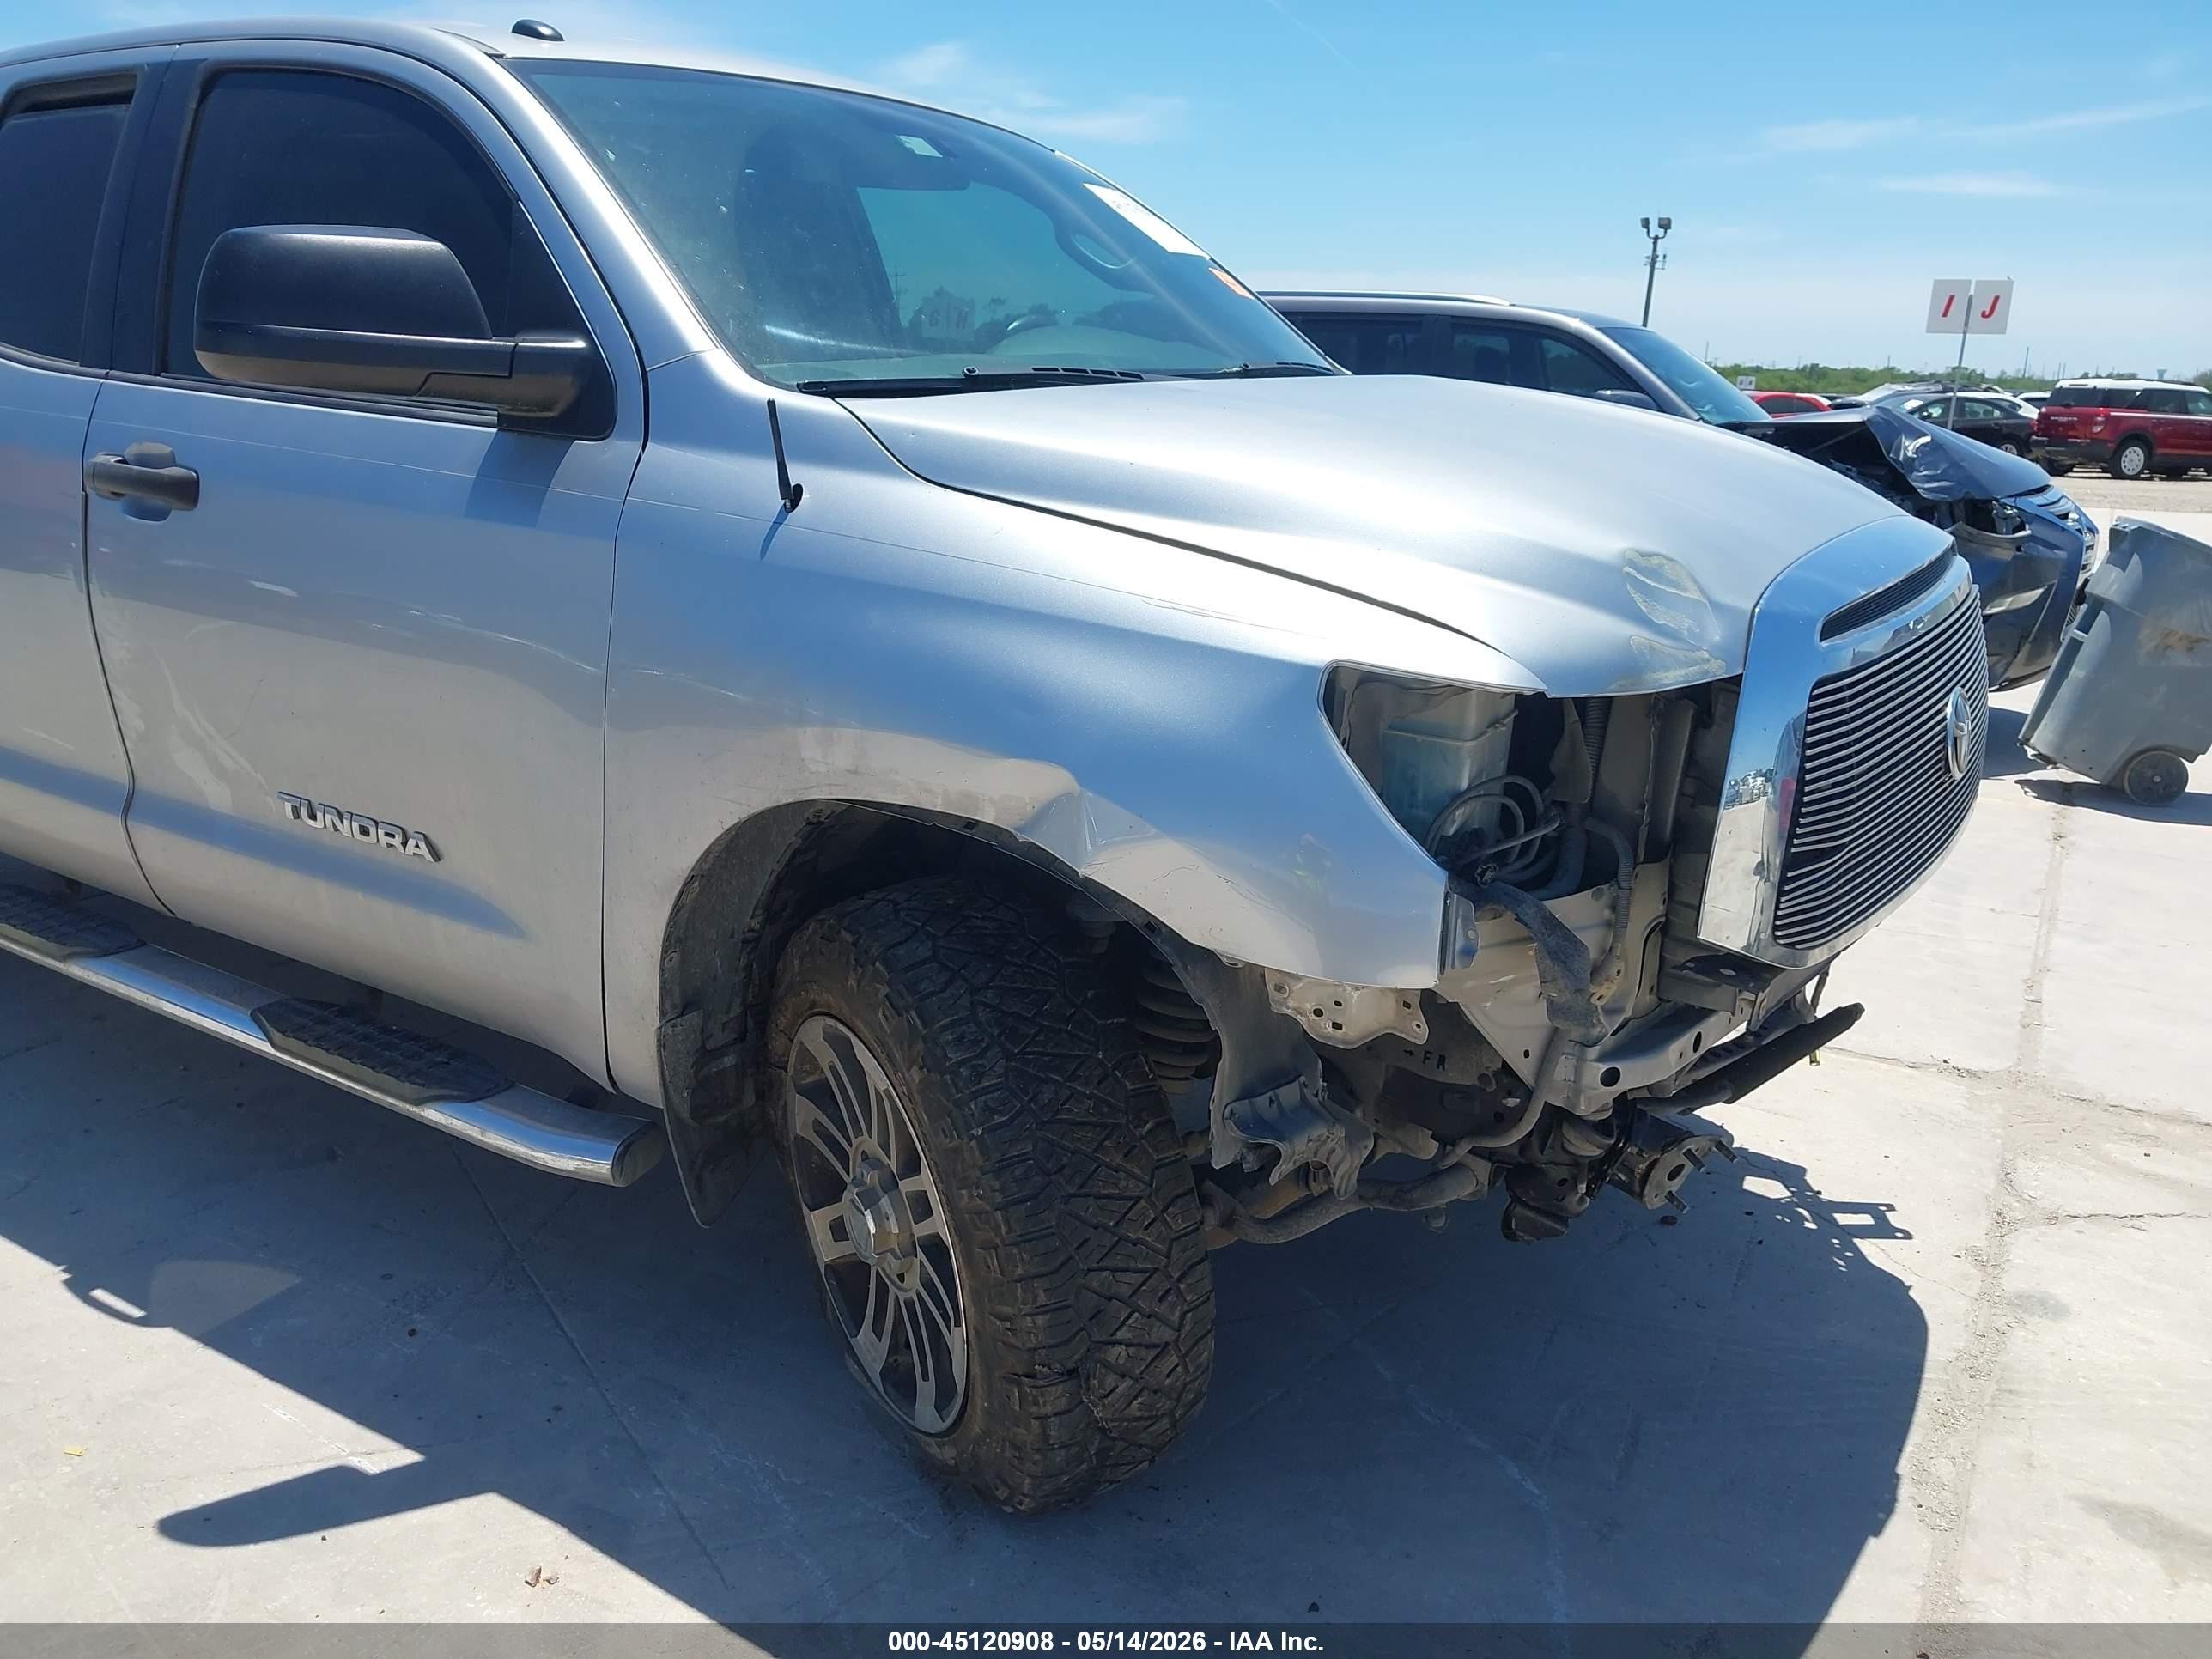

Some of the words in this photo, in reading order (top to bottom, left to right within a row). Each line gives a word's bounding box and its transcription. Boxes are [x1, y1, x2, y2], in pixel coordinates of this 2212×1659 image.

[1941, 294, 1955, 319] I
[1980, 295, 2002, 319] J
[276, 791, 441, 863] TUNDRA
